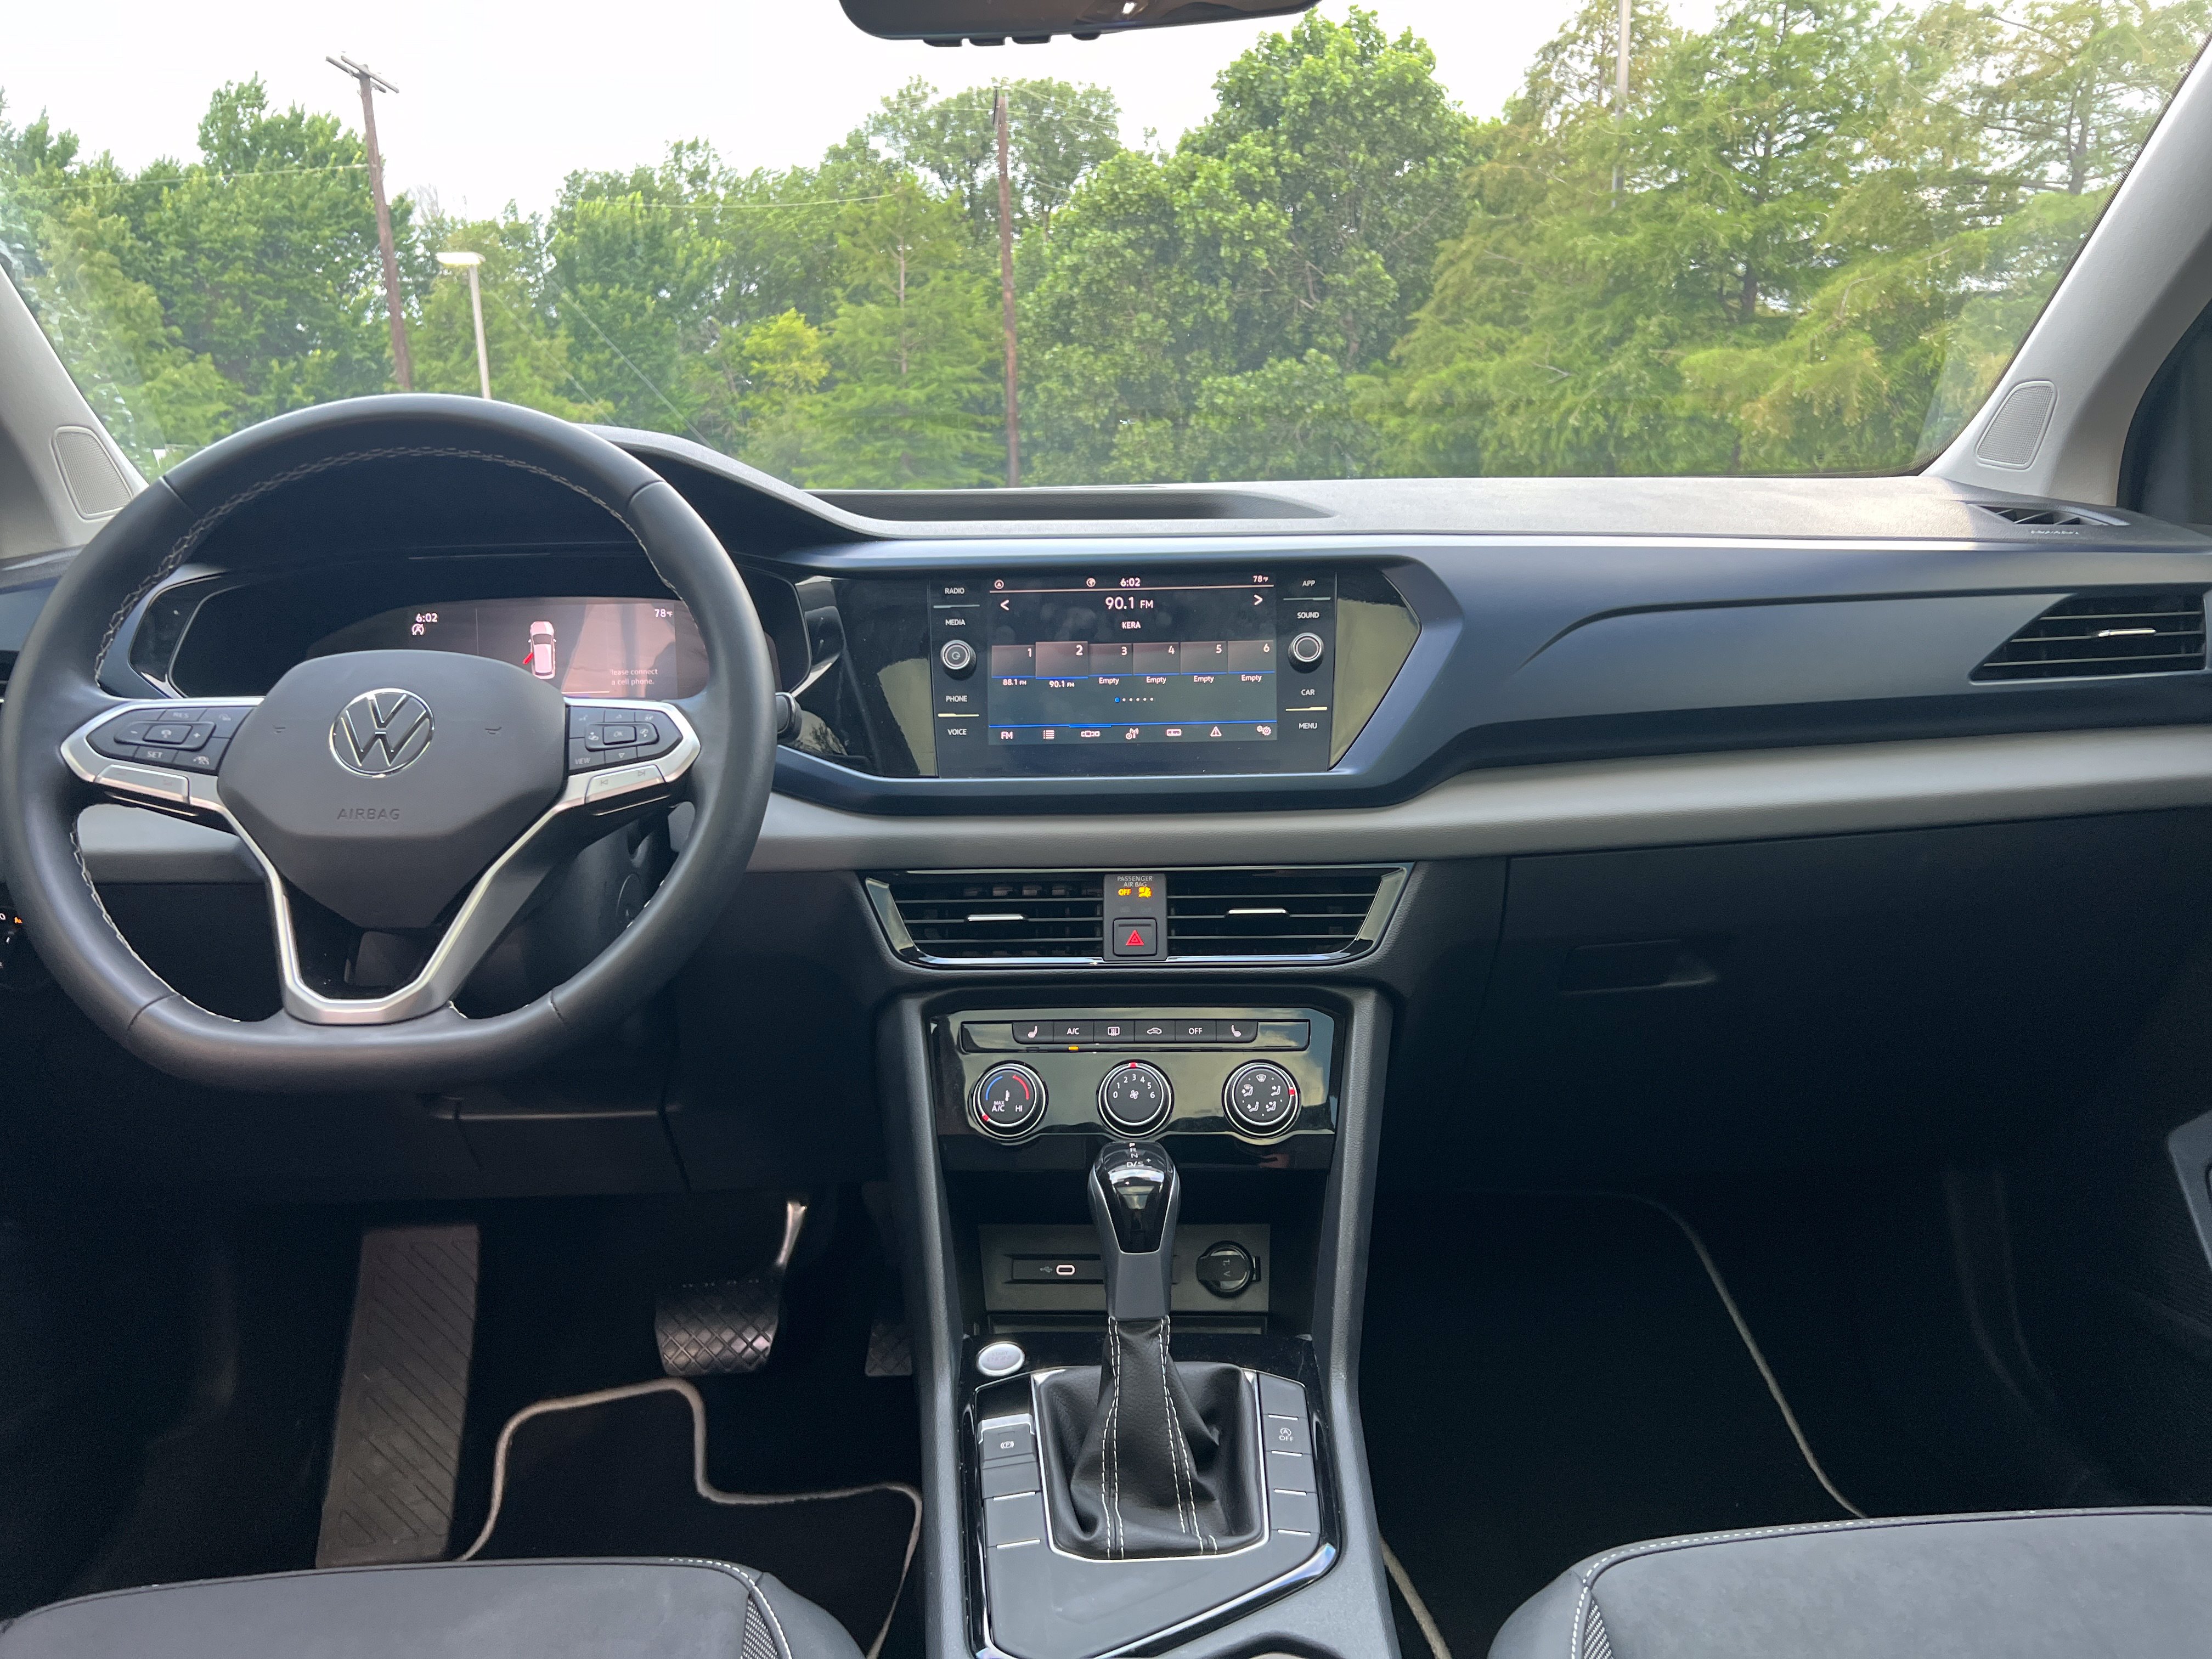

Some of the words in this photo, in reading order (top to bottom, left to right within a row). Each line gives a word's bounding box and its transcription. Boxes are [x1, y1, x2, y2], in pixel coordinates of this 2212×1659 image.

[1120, 578, 1141, 588] 6:02
[1105, 596, 1135, 610] 90.1
[1140, 600, 1154, 610] FM
[416, 613, 438, 623] 6:02
[1122, 621, 1141, 629] KERA
[1027, 648, 1032, 657] 1
[1076, 645, 1083, 656] 2
[1121, 646, 1127, 656] 3
[1168, 645, 1175, 655] 4
[1216, 644, 1222, 654] 5
[1263, 643, 1270, 653] 6
[631, 678, 654, 686] phone.
[1099, 677, 1120, 685] Empty
[1146, 676, 1167, 684] Empty
[1194, 675, 1214, 684] Empty
[1241, 674, 1262, 682] Empty
[1001, 731, 1013, 740] FM
[575, 757, 591, 765] VIEW
[337, 808, 400, 820] AIRBAG
